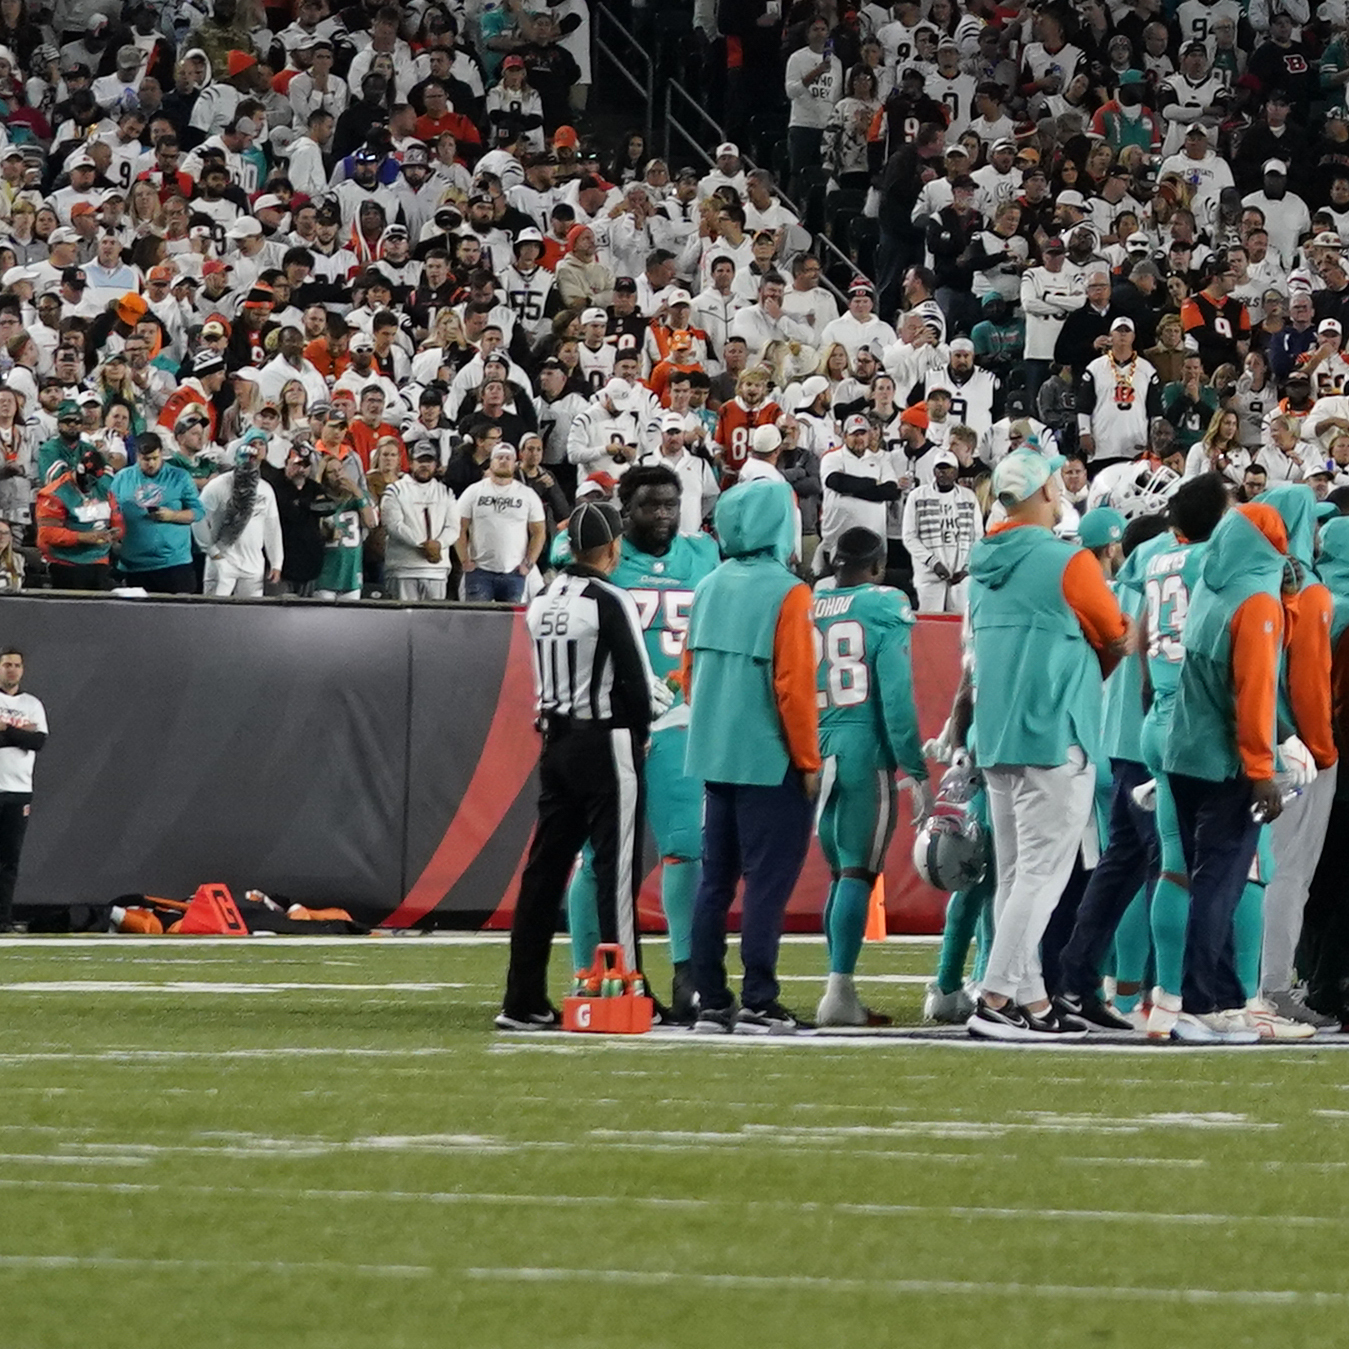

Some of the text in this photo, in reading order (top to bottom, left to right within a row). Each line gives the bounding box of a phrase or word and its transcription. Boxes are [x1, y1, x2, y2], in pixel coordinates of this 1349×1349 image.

[1283, 53, 1308, 74] B
[904, 117, 920, 142] 9
[119, 161, 132, 188] 9
[541, 211, 548, 233] 1
[1215, 317, 1231, 339] 9
[949, 399, 967, 425] 9
[478, 496, 523, 508] BENGALS
[541, 612, 569, 637] 58
[629, 588, 690, 656] 75
[577, 1005, 590, 1027] G
